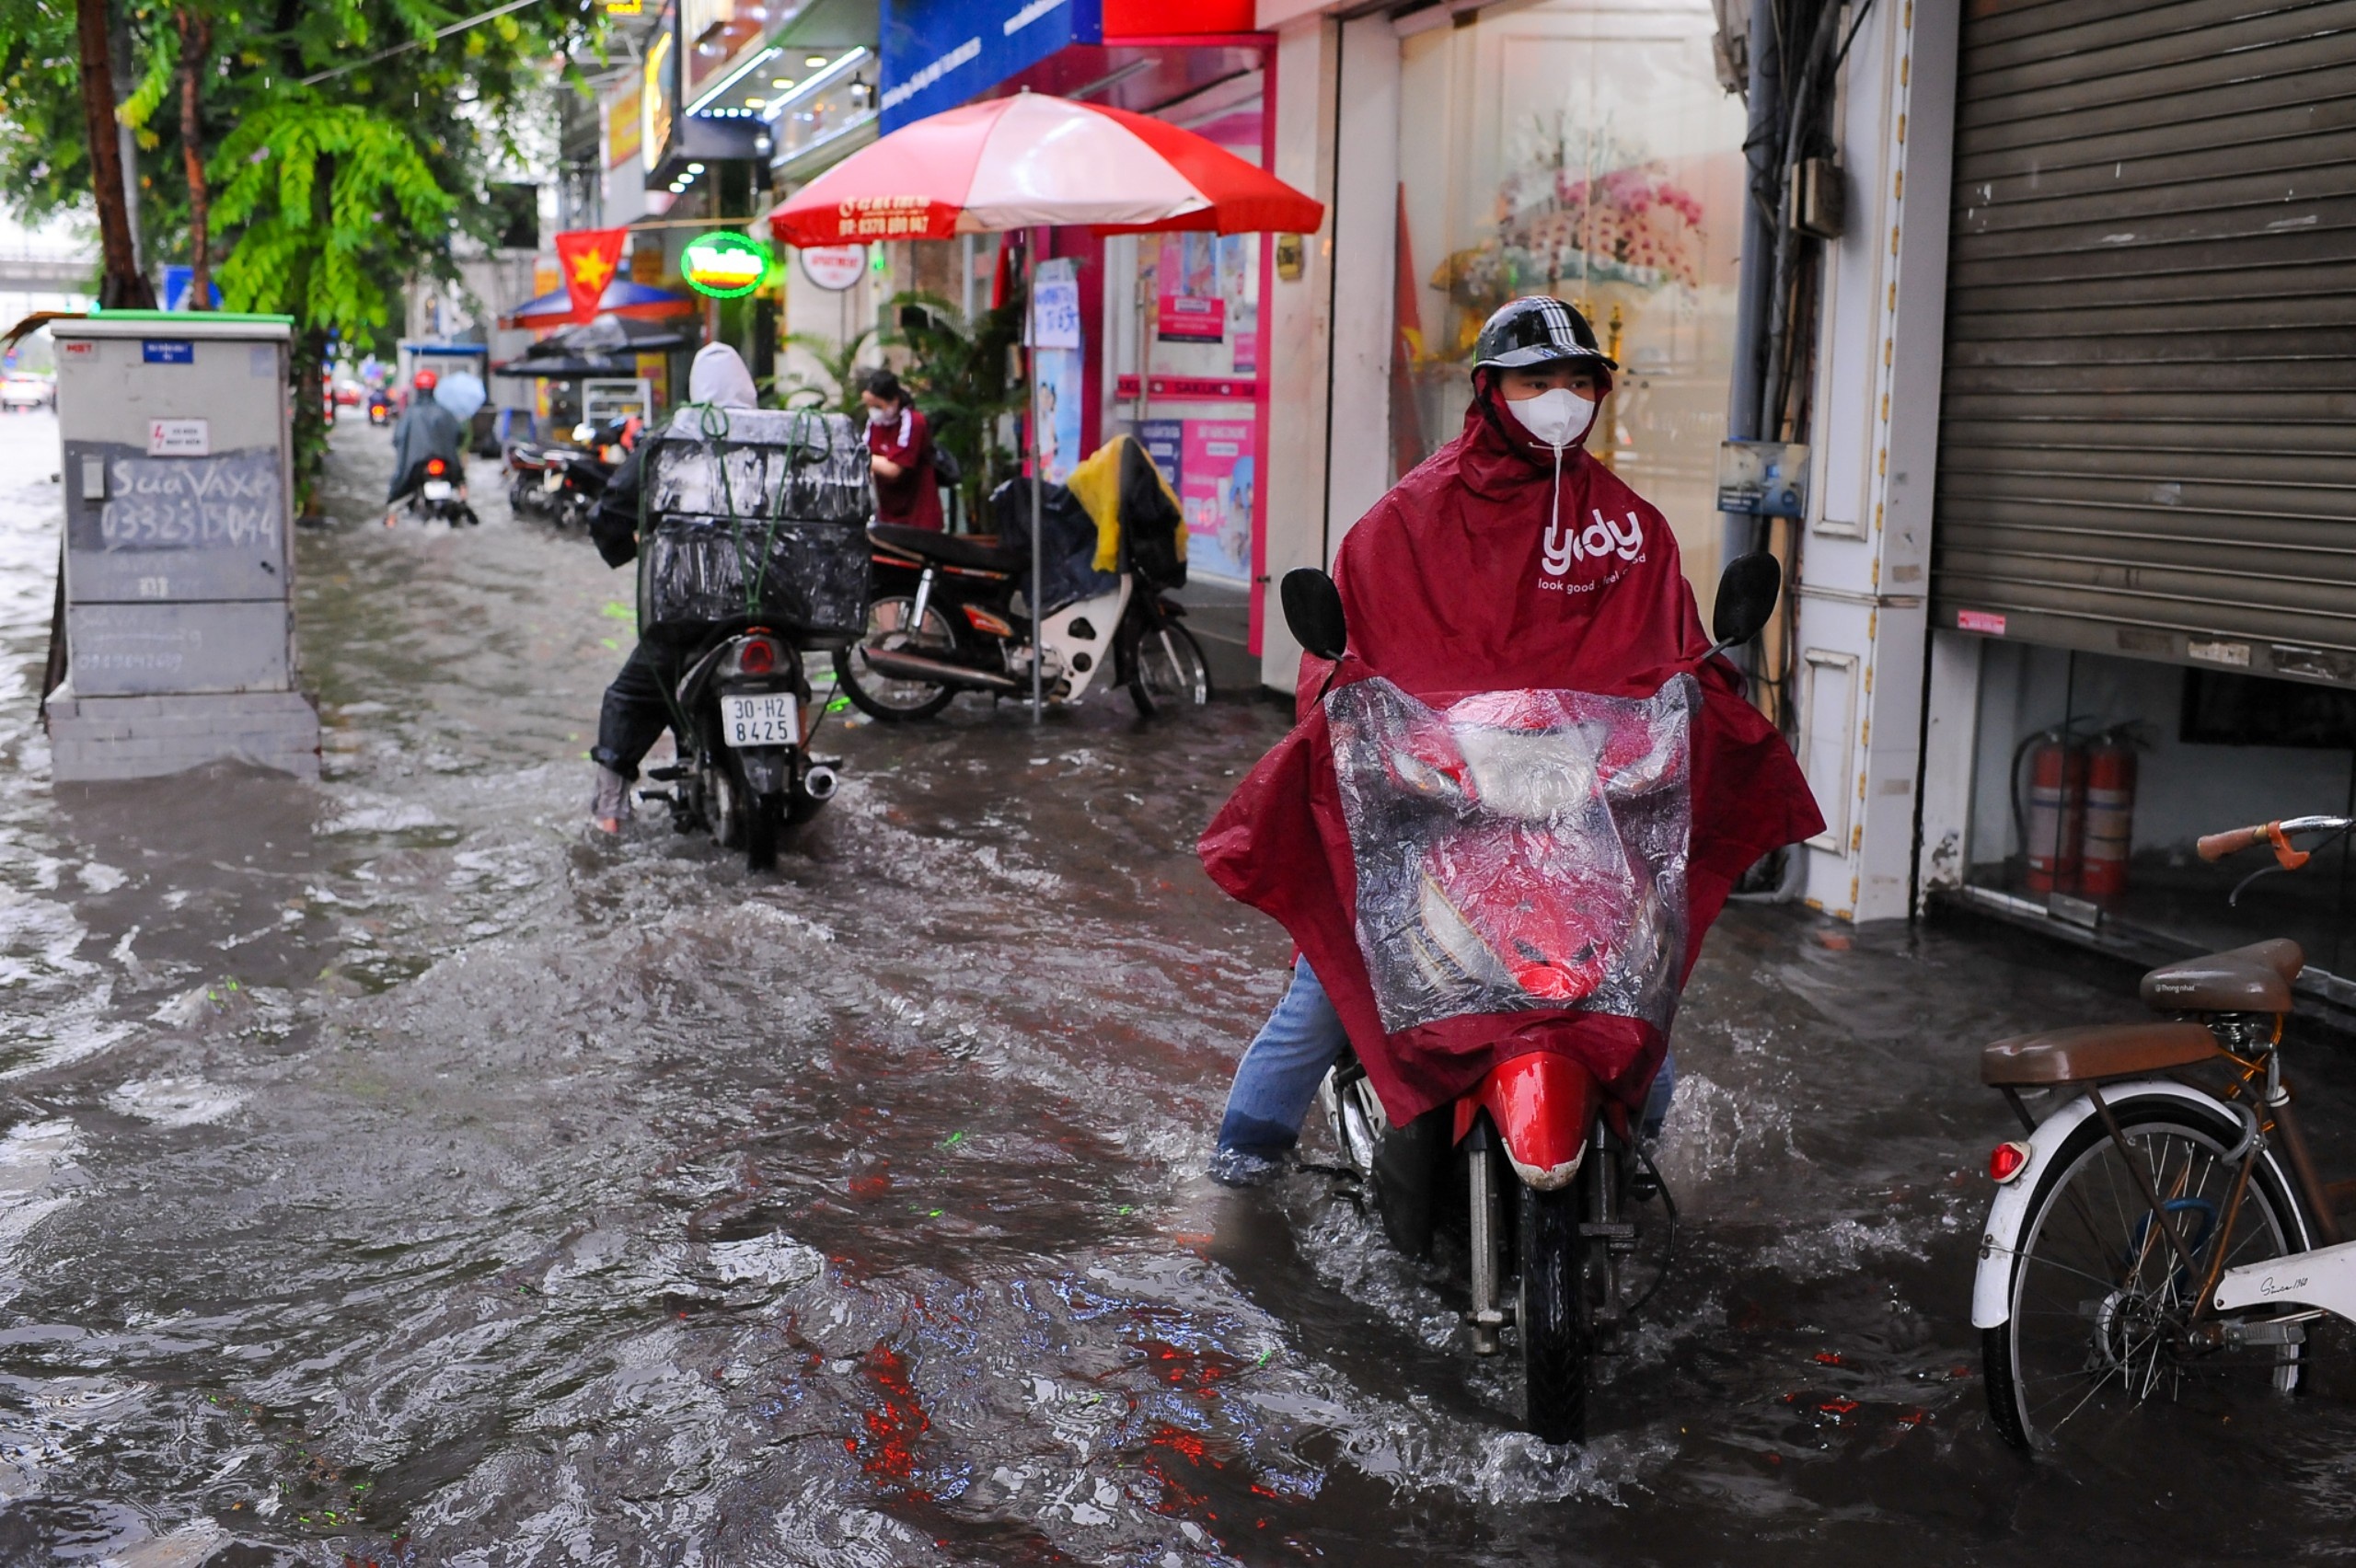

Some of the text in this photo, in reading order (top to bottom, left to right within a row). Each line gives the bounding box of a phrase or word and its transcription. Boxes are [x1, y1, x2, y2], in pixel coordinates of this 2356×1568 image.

[1538, 578, 1564, 590] look
[1566, 580, 1595, 594] good
[736, 721, 788, 742] 8425
[2260, 1276, 2292, 1297] Since
